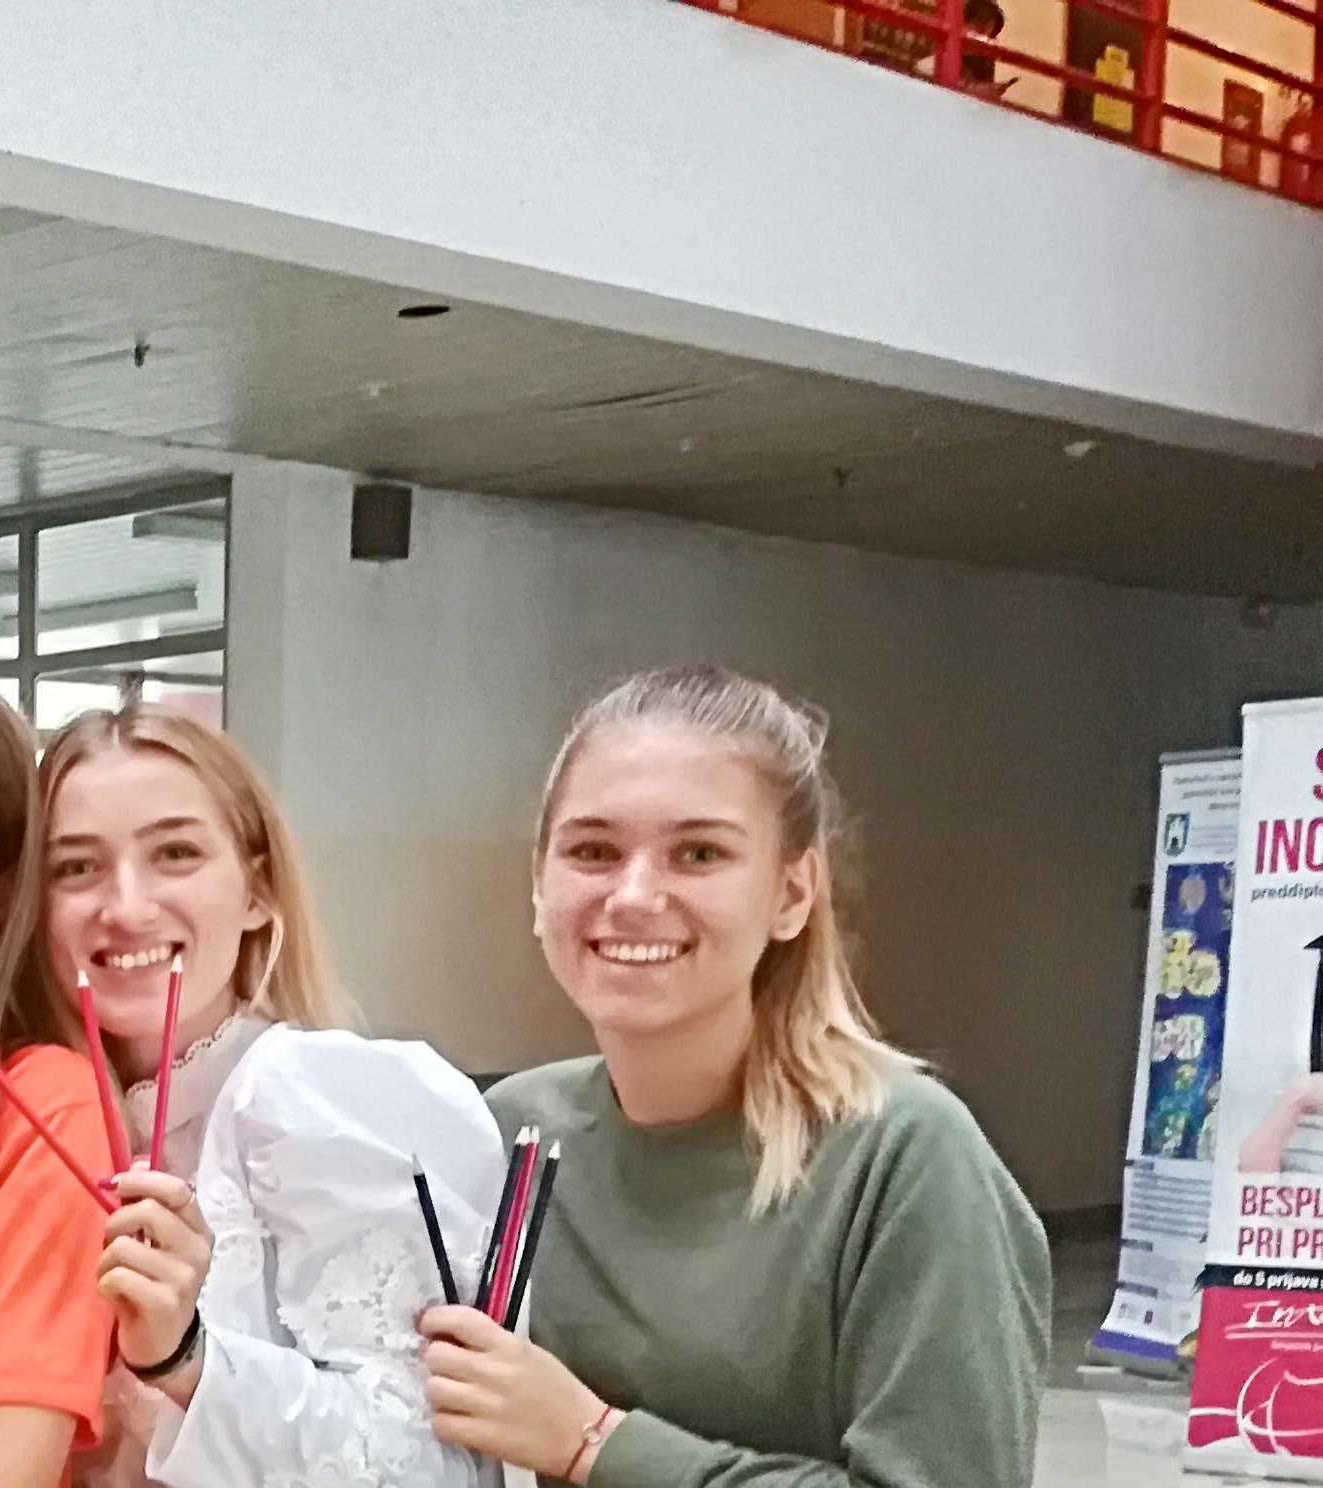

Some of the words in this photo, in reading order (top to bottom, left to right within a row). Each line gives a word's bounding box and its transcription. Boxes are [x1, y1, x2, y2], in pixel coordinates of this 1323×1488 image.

[1238, 1226, 1282, 1258] PRI
[1234, 1269, 1253, 1286] do
[1267, 1271, 1319, 1291] prijava
